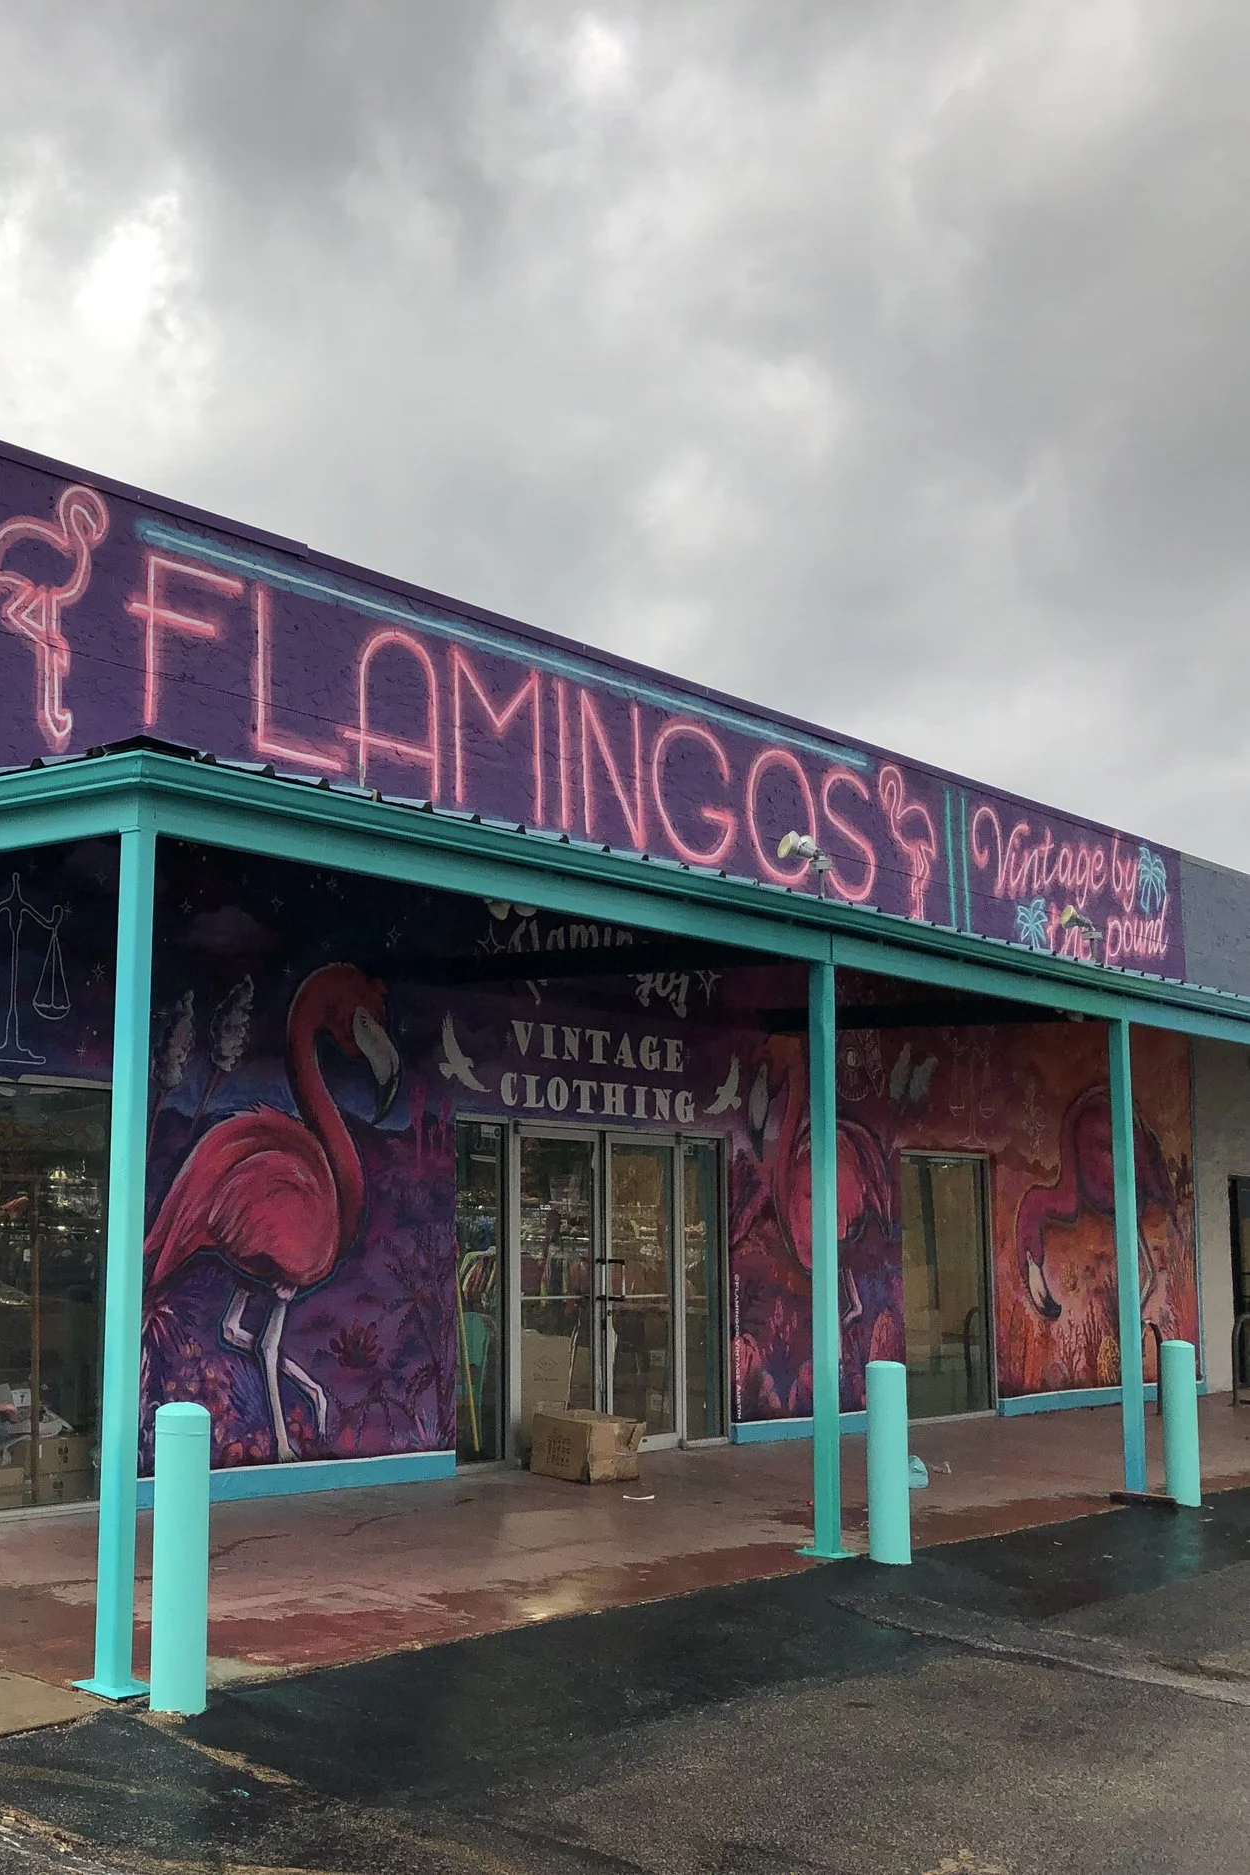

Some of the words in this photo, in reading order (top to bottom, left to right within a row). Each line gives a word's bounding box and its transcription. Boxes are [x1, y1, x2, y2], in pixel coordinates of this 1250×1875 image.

[127, 554, 877, 904] FLAMINGOS
[971, 804, 1107, 911] Vintage
[1111, 832, 1139, 913] by
[1105, 893, 1170, 966] pound
[511, 1019, 684, 1073] VINTAGE
[499, 1071, 696, 1123] CLOTHING
